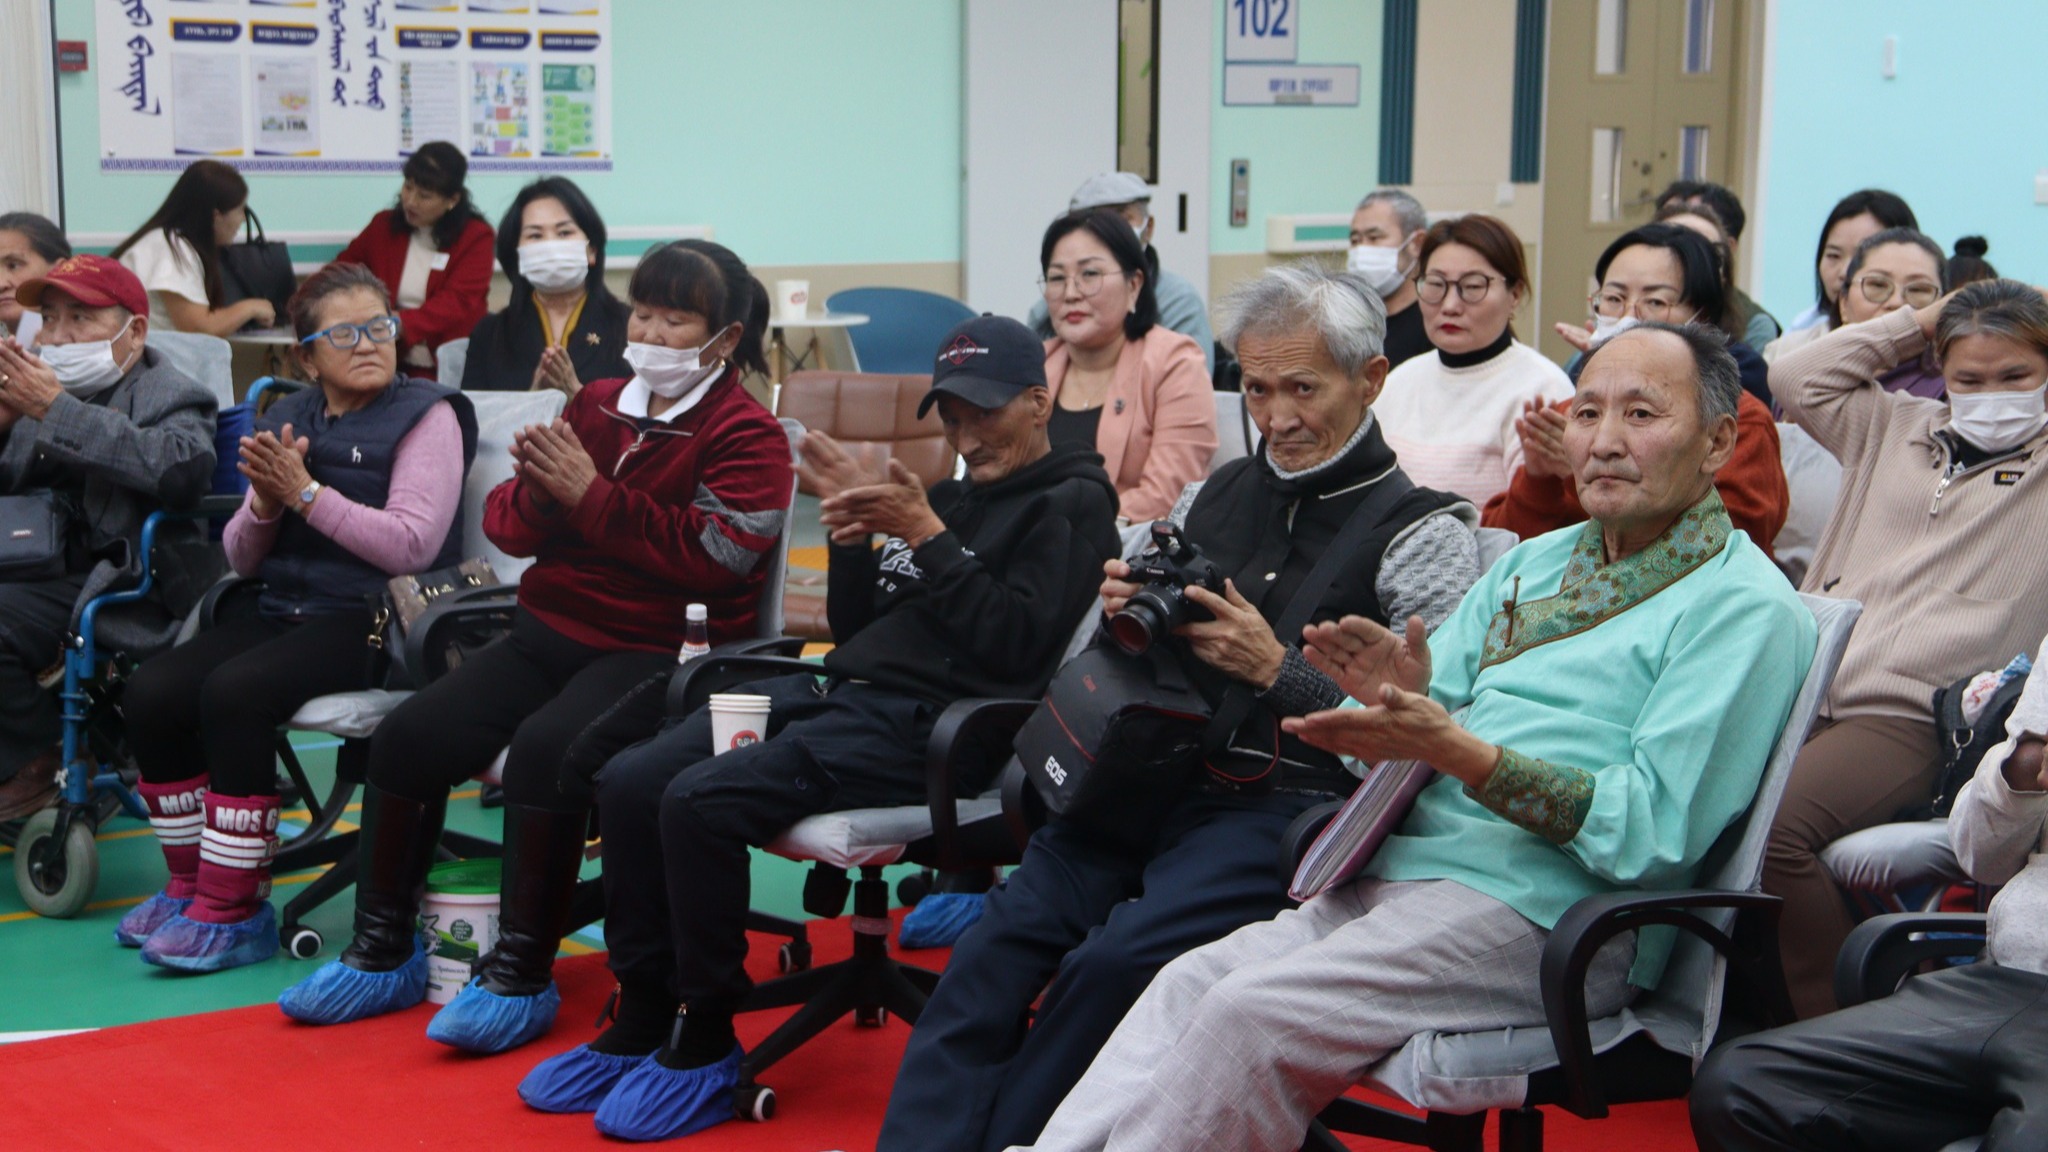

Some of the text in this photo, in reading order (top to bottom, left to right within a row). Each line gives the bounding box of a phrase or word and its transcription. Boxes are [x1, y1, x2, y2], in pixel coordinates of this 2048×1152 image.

[1234, 0, 1289, 37] 102
[1045, 755, 1068, 786] EOS
[215, 806, 263, 833] MOS
